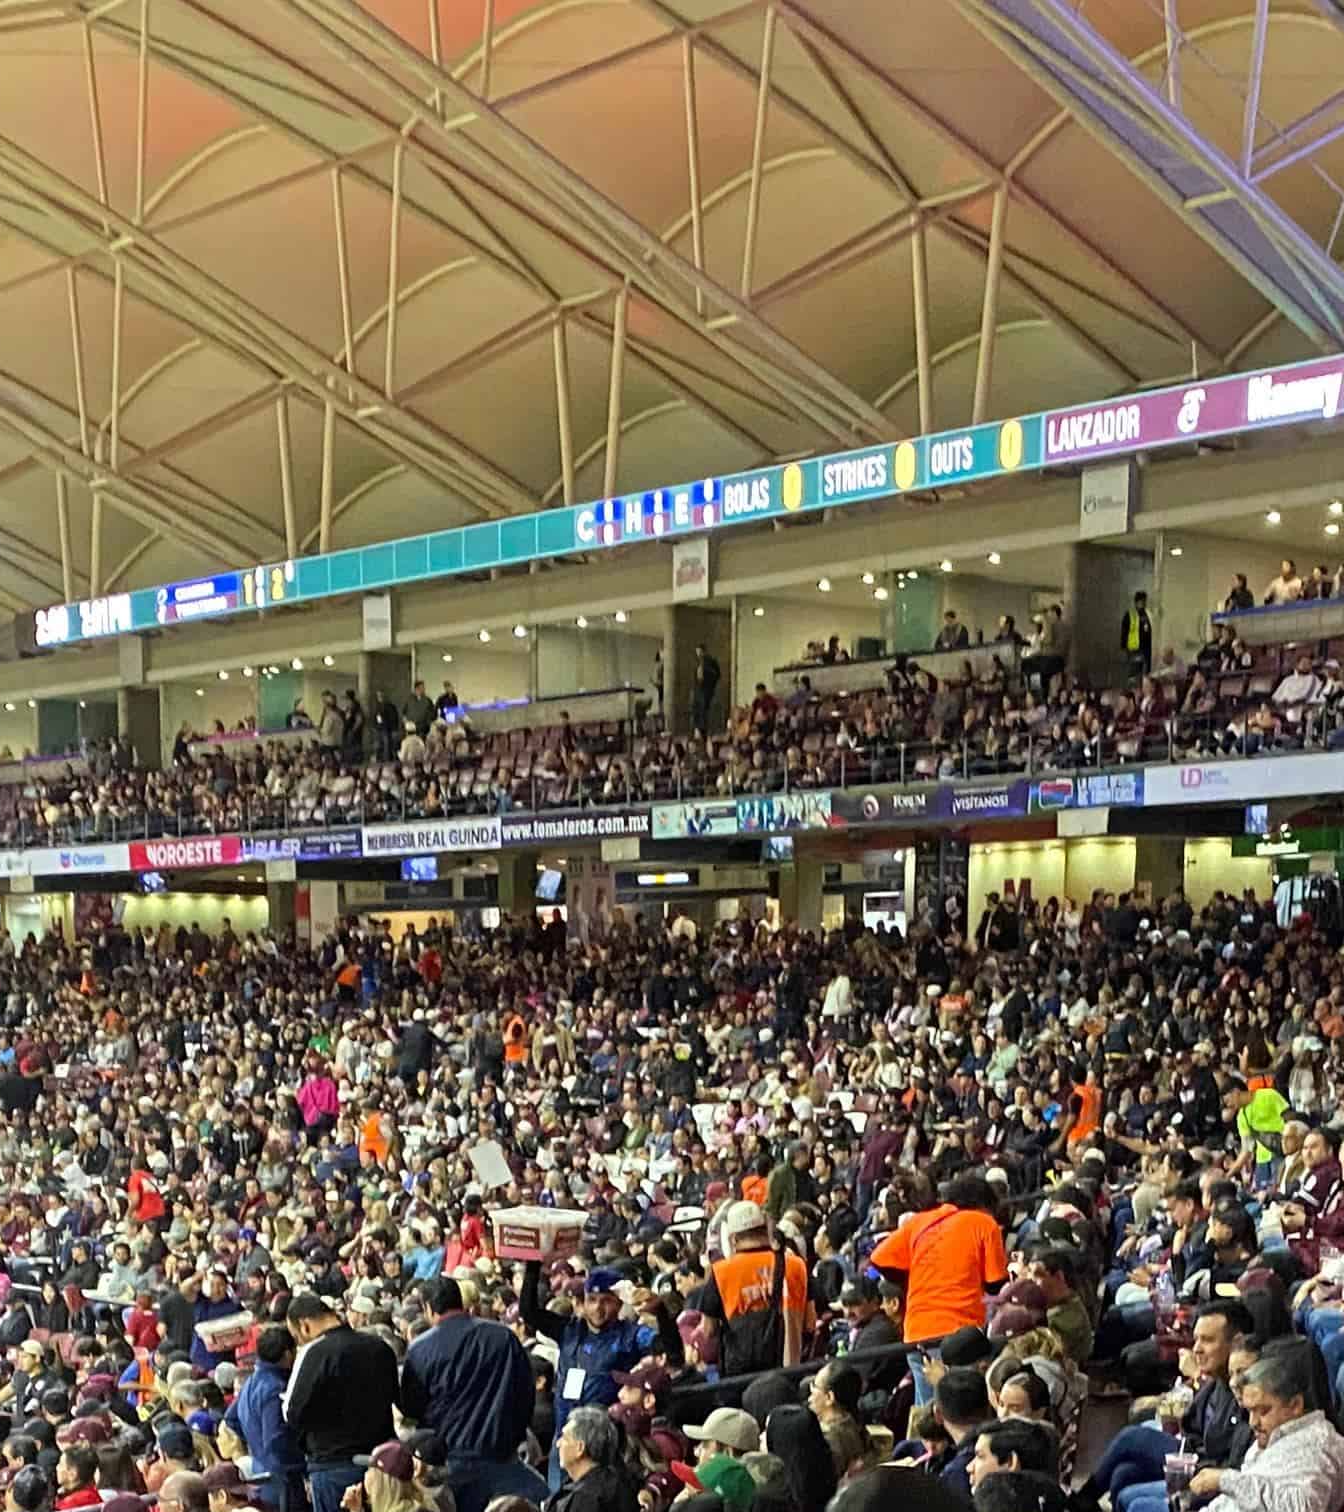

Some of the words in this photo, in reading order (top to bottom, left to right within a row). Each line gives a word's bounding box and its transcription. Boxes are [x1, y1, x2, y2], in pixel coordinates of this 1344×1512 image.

[1047, 403, 1141, 454] LANZADOR
[931, 436, 974, 476] OUTS
[823, 454, 888, 498] STRIKES
[674, 493, 689, 524] E
[724, 476, 771, 516] BOLAS
[577, 510, 594, 542] C
[625, 500, 642, 534] H
[417, 829, 447, 849] REAL
[448, 825, 499, 846] GUINDA
[502, 814, 649, 841] www.tomateros.com.mx
[144, 839, 223, 866] NOROESTE
